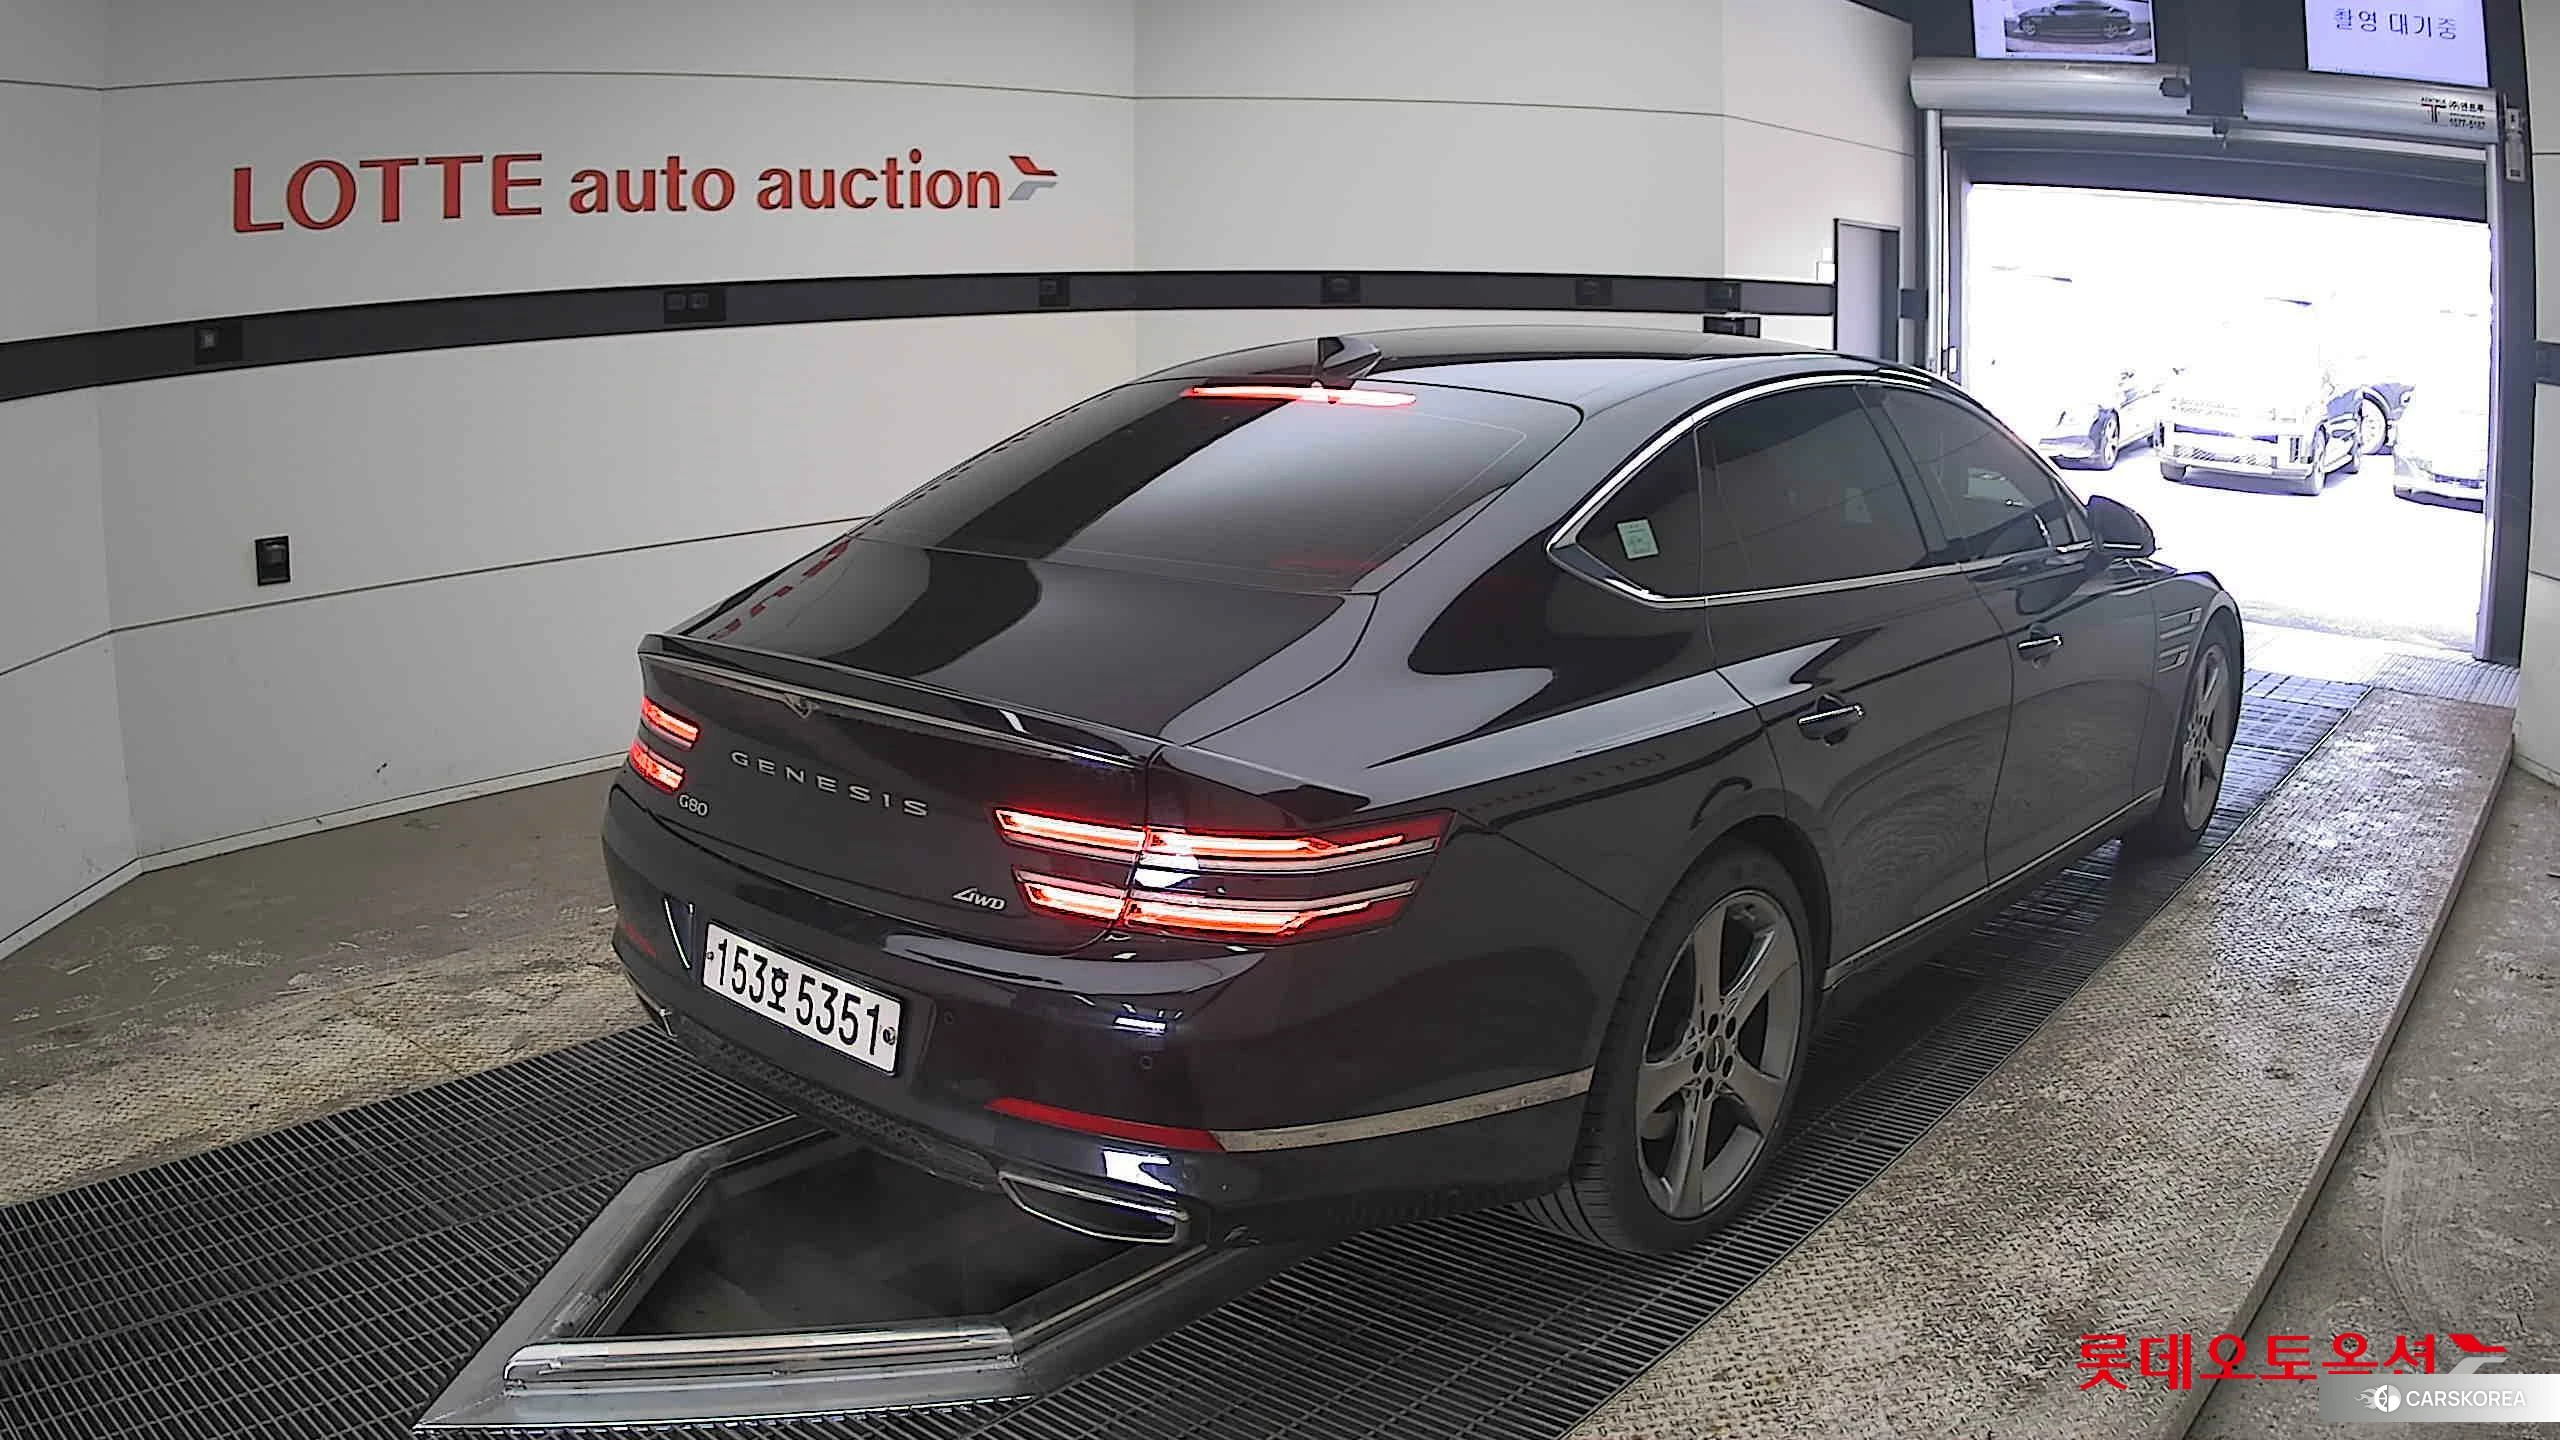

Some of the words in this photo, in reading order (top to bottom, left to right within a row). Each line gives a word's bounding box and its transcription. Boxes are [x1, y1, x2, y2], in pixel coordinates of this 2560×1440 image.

[233, 153, 542, 233] LOTTE
[569, 155, 736, 213] auto
[756, 147, 1001, 209] auction
[679, 793, 709, 817] G80
[731, 752, 928, 816] GENESIS
